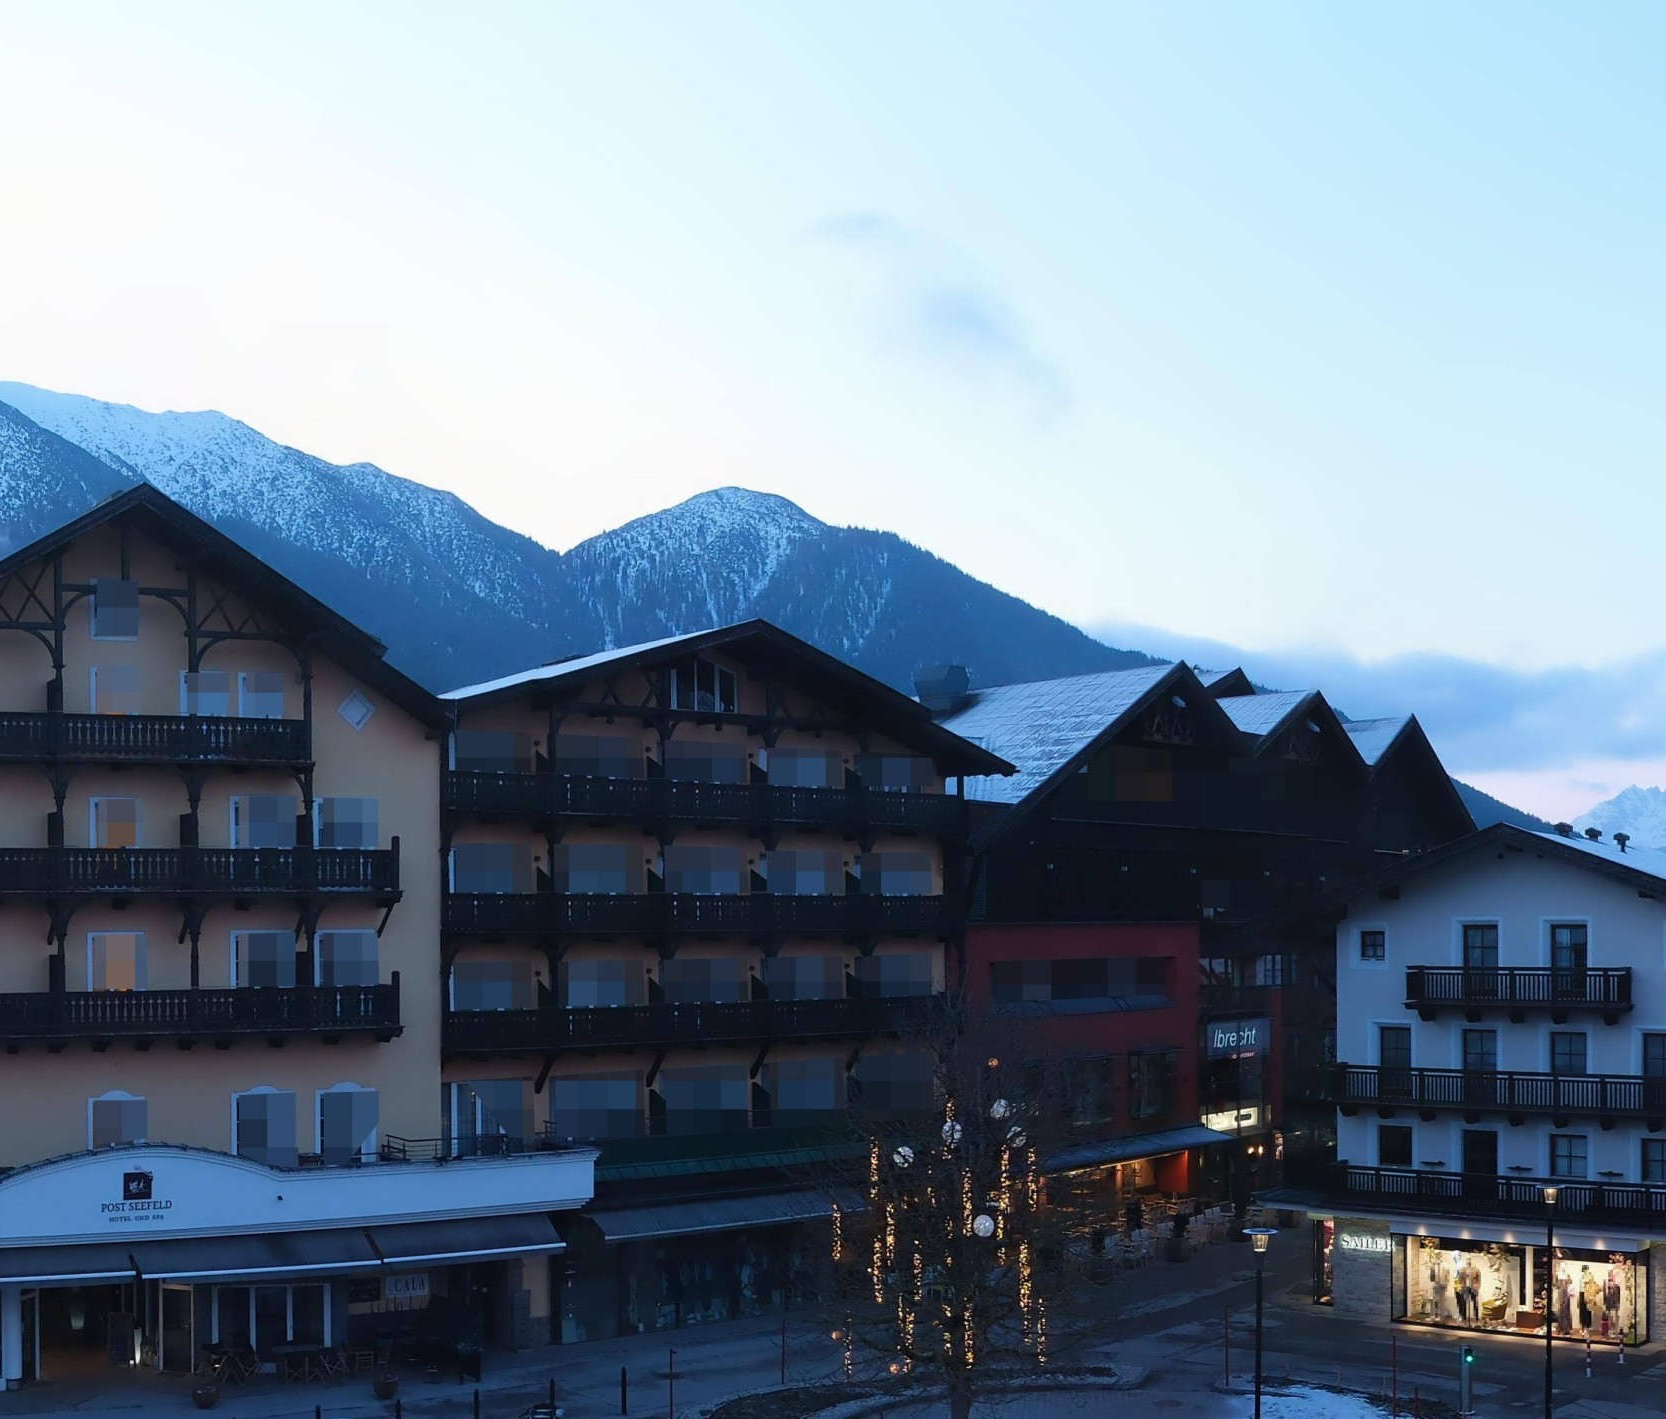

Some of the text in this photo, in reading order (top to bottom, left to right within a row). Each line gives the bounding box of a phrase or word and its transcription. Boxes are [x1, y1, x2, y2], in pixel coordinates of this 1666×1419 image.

[101, 1200, 173, 1213] POST SEEFELD
[108, 1215, 132, 1223] HOTEL
[134, 1214, 150, 1222] UND
[1340, 1234, 1396, 1252] SAILER
